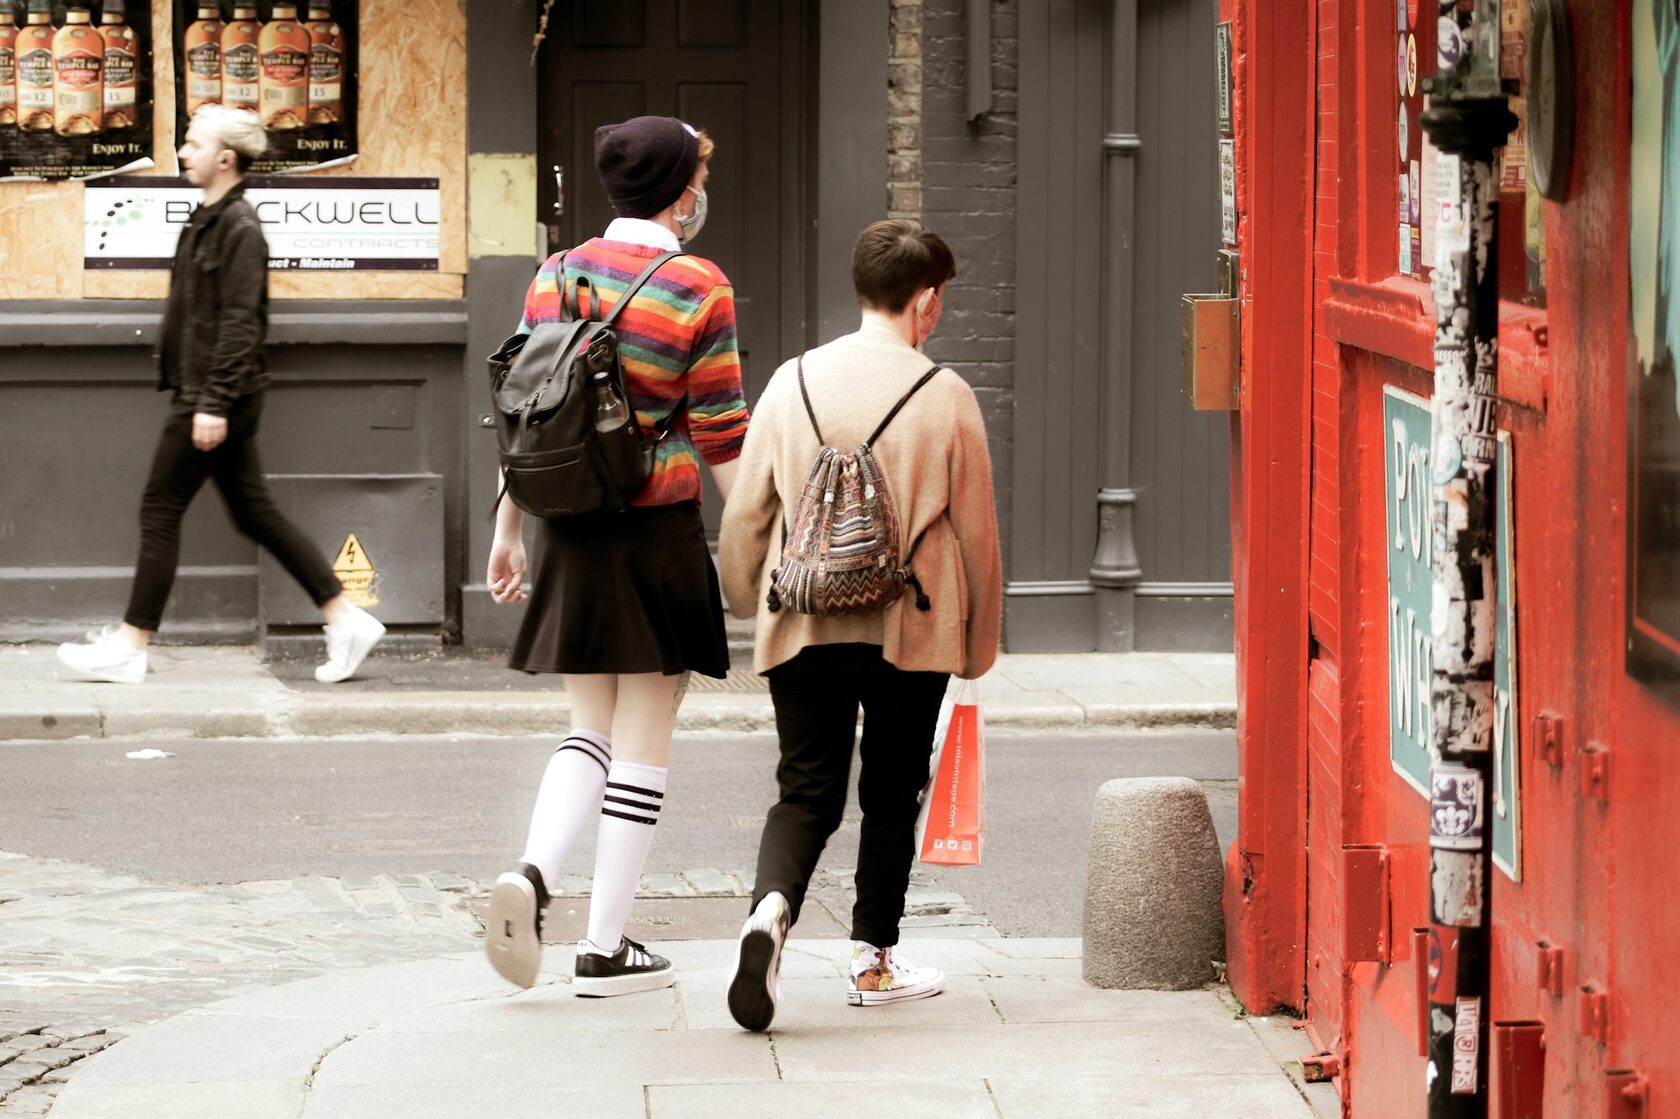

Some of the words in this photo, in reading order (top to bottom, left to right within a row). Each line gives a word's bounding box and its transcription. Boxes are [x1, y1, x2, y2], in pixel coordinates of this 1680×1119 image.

[240, 87, 251, 96] 12
[314, 87, 326, 97] 15
[35, 93, 46, 101] 12
[108, 93, 121, 101] 15
[166, 201, 438, 225] BCKWELL
[293, 238, 440, 249] CONTRACTS
[299, 257, 355, 269] Maintain
